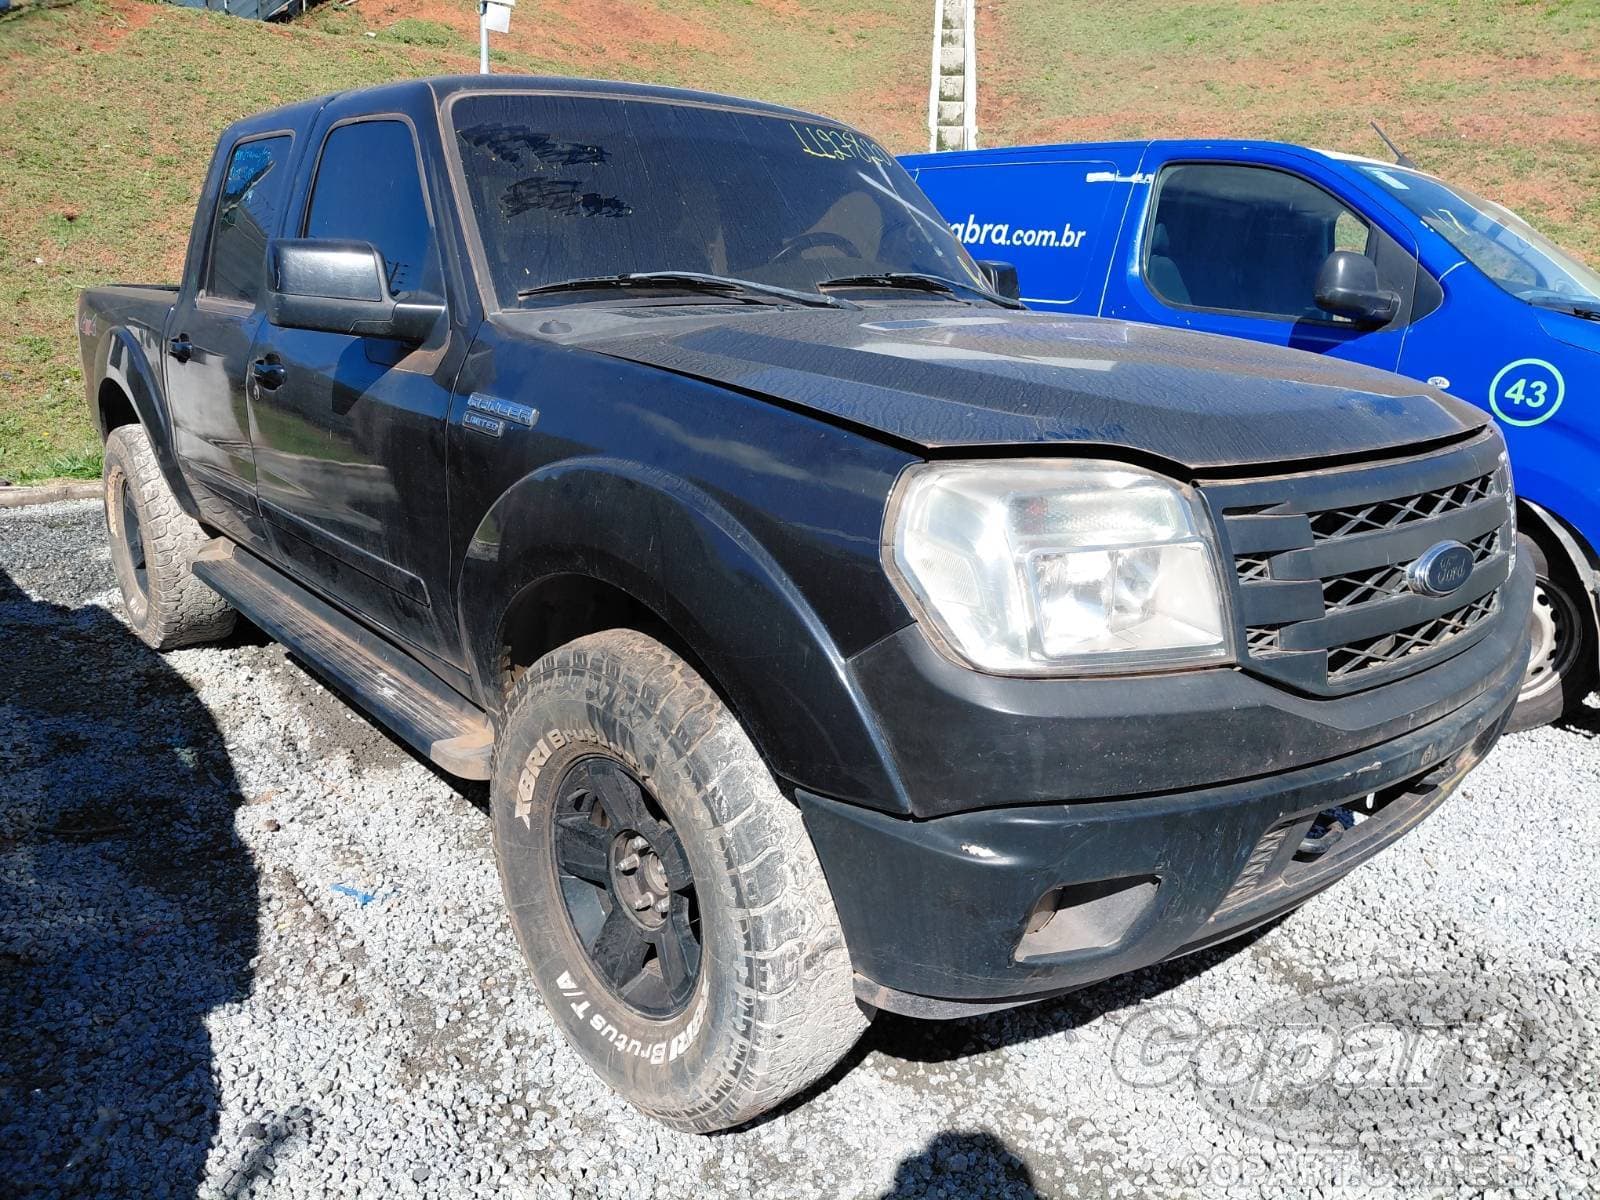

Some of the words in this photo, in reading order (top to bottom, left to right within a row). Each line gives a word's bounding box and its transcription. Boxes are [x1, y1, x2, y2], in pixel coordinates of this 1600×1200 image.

[947, 213, 1087, 248] abra.com.br
[1504, 378, 1548, 408] 43
[464, 413, 499, 431] LIMITED
[1437, 556, 1466, 584] Ford
[555, 970, 592, 1020] T/A
[589, 1013, 668, 1066] Brutus
